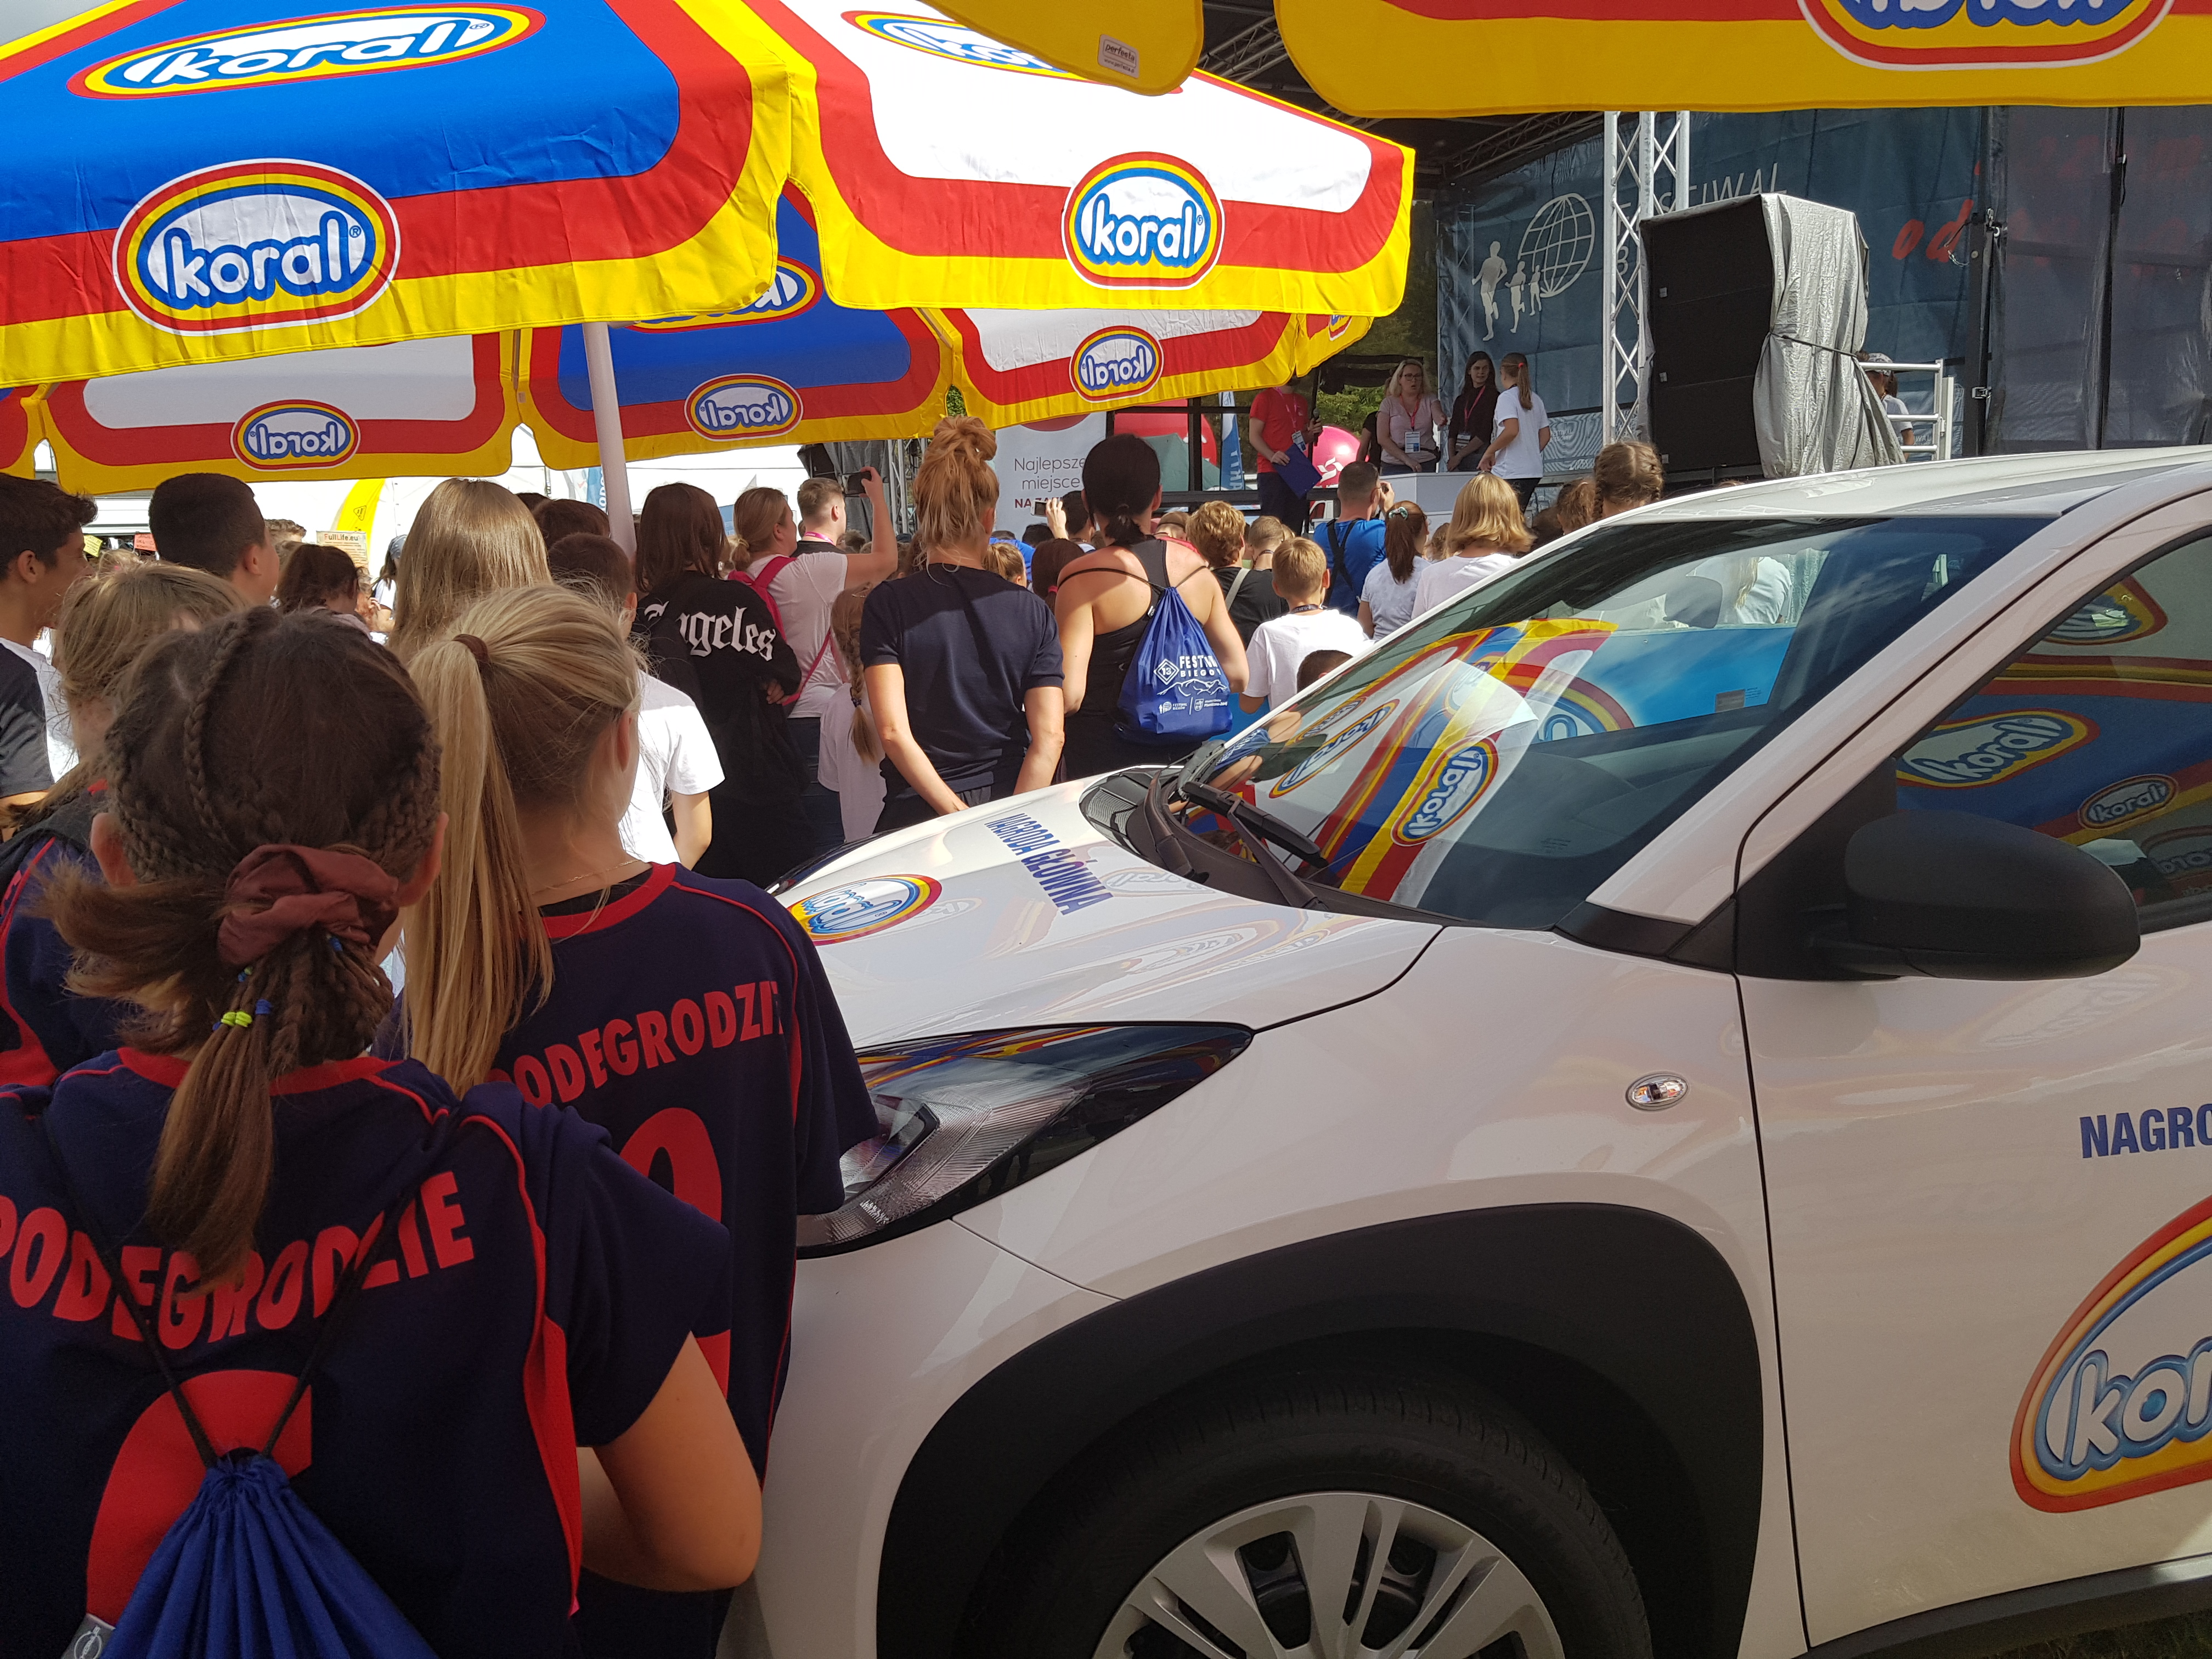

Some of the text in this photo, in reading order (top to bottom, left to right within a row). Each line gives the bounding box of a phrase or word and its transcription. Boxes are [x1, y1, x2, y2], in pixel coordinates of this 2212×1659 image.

[149, 21, 460, 84] koral
[1105, 44, 1135, 61] perfesta
[1093, 199, 1194, 259] koral
[172, 218, 343, 300] koral
[1014, 456, 1086, 474] Najlepsze
[1022, 476, 1080, 492] miejsce
[1014, 498, 1031, 508] NA
[1161, 667, 1172, 675] 13
[984, 812, 1114, 915] NAGRODA GŁÓWNA
[802, 882, 902, 930] koral
[487, 980, 785, 1110] ODEGRODZI
